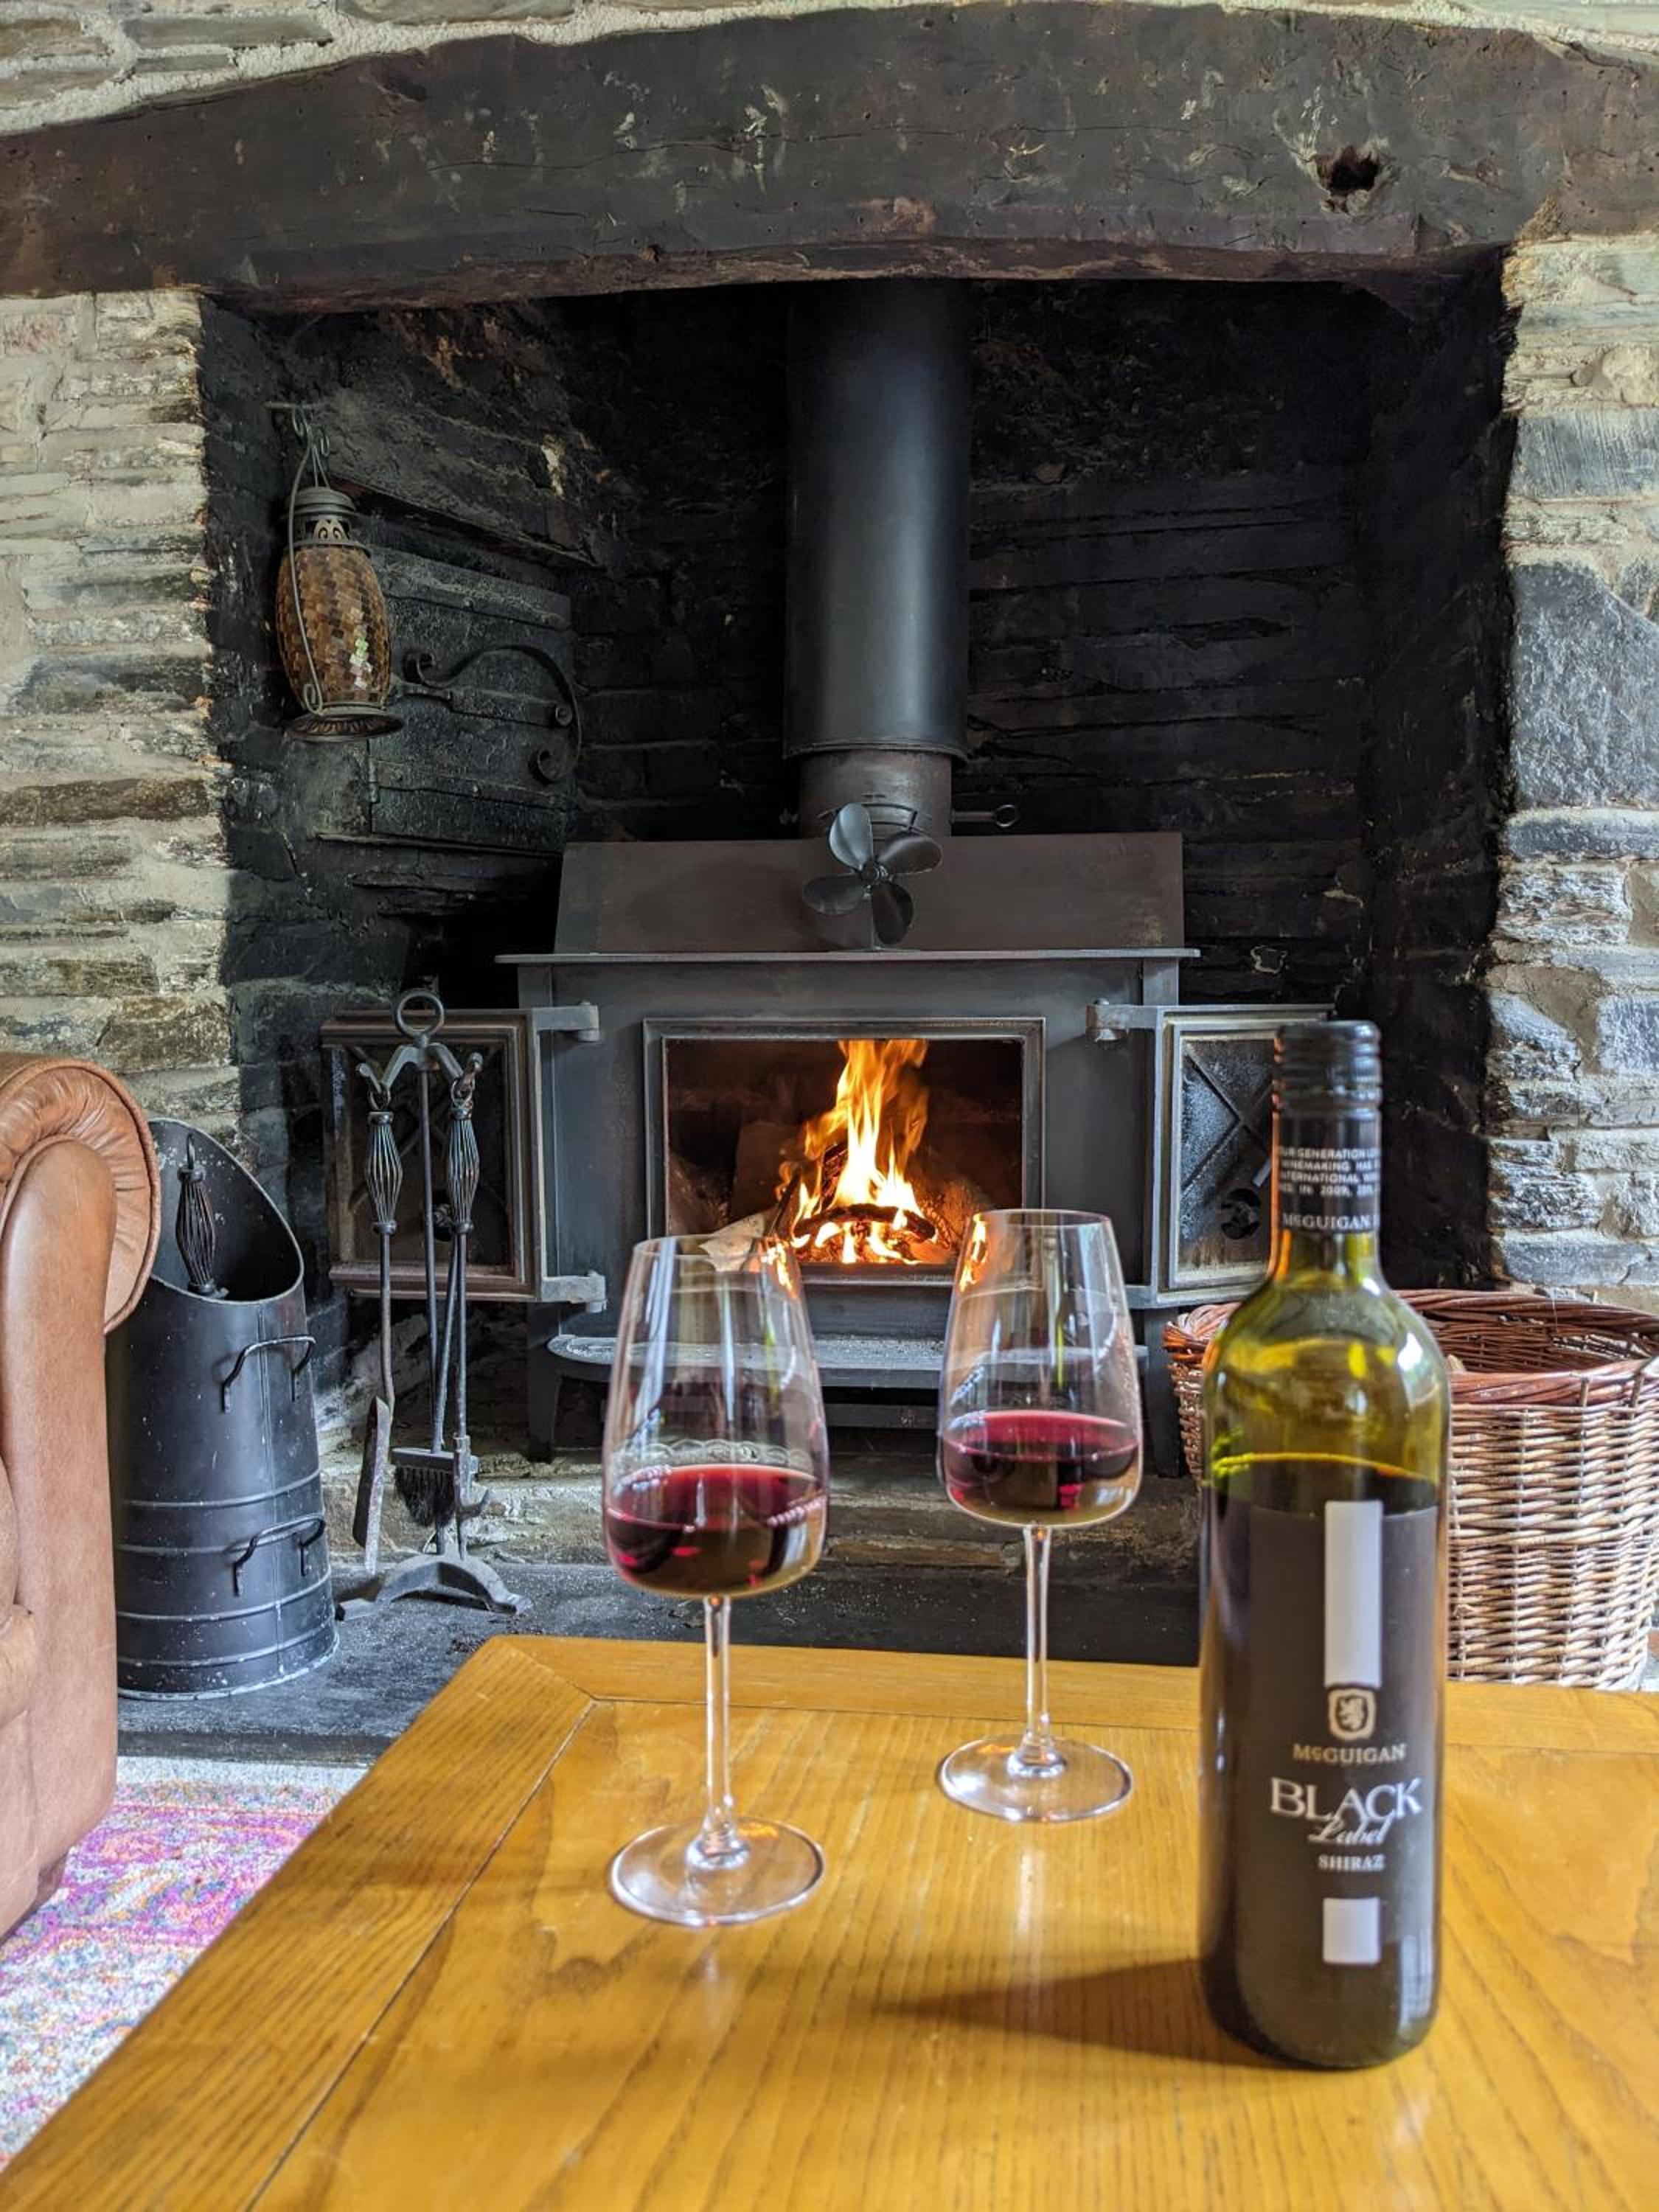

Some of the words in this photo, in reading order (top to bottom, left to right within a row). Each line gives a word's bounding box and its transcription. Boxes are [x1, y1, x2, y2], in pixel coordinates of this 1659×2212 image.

[1270, 1777, 1423, 1822] BLACK
[1308, 1815, 1394, 1845] Label
[1318, 1855, 1384, 1872] SHIRAZ
